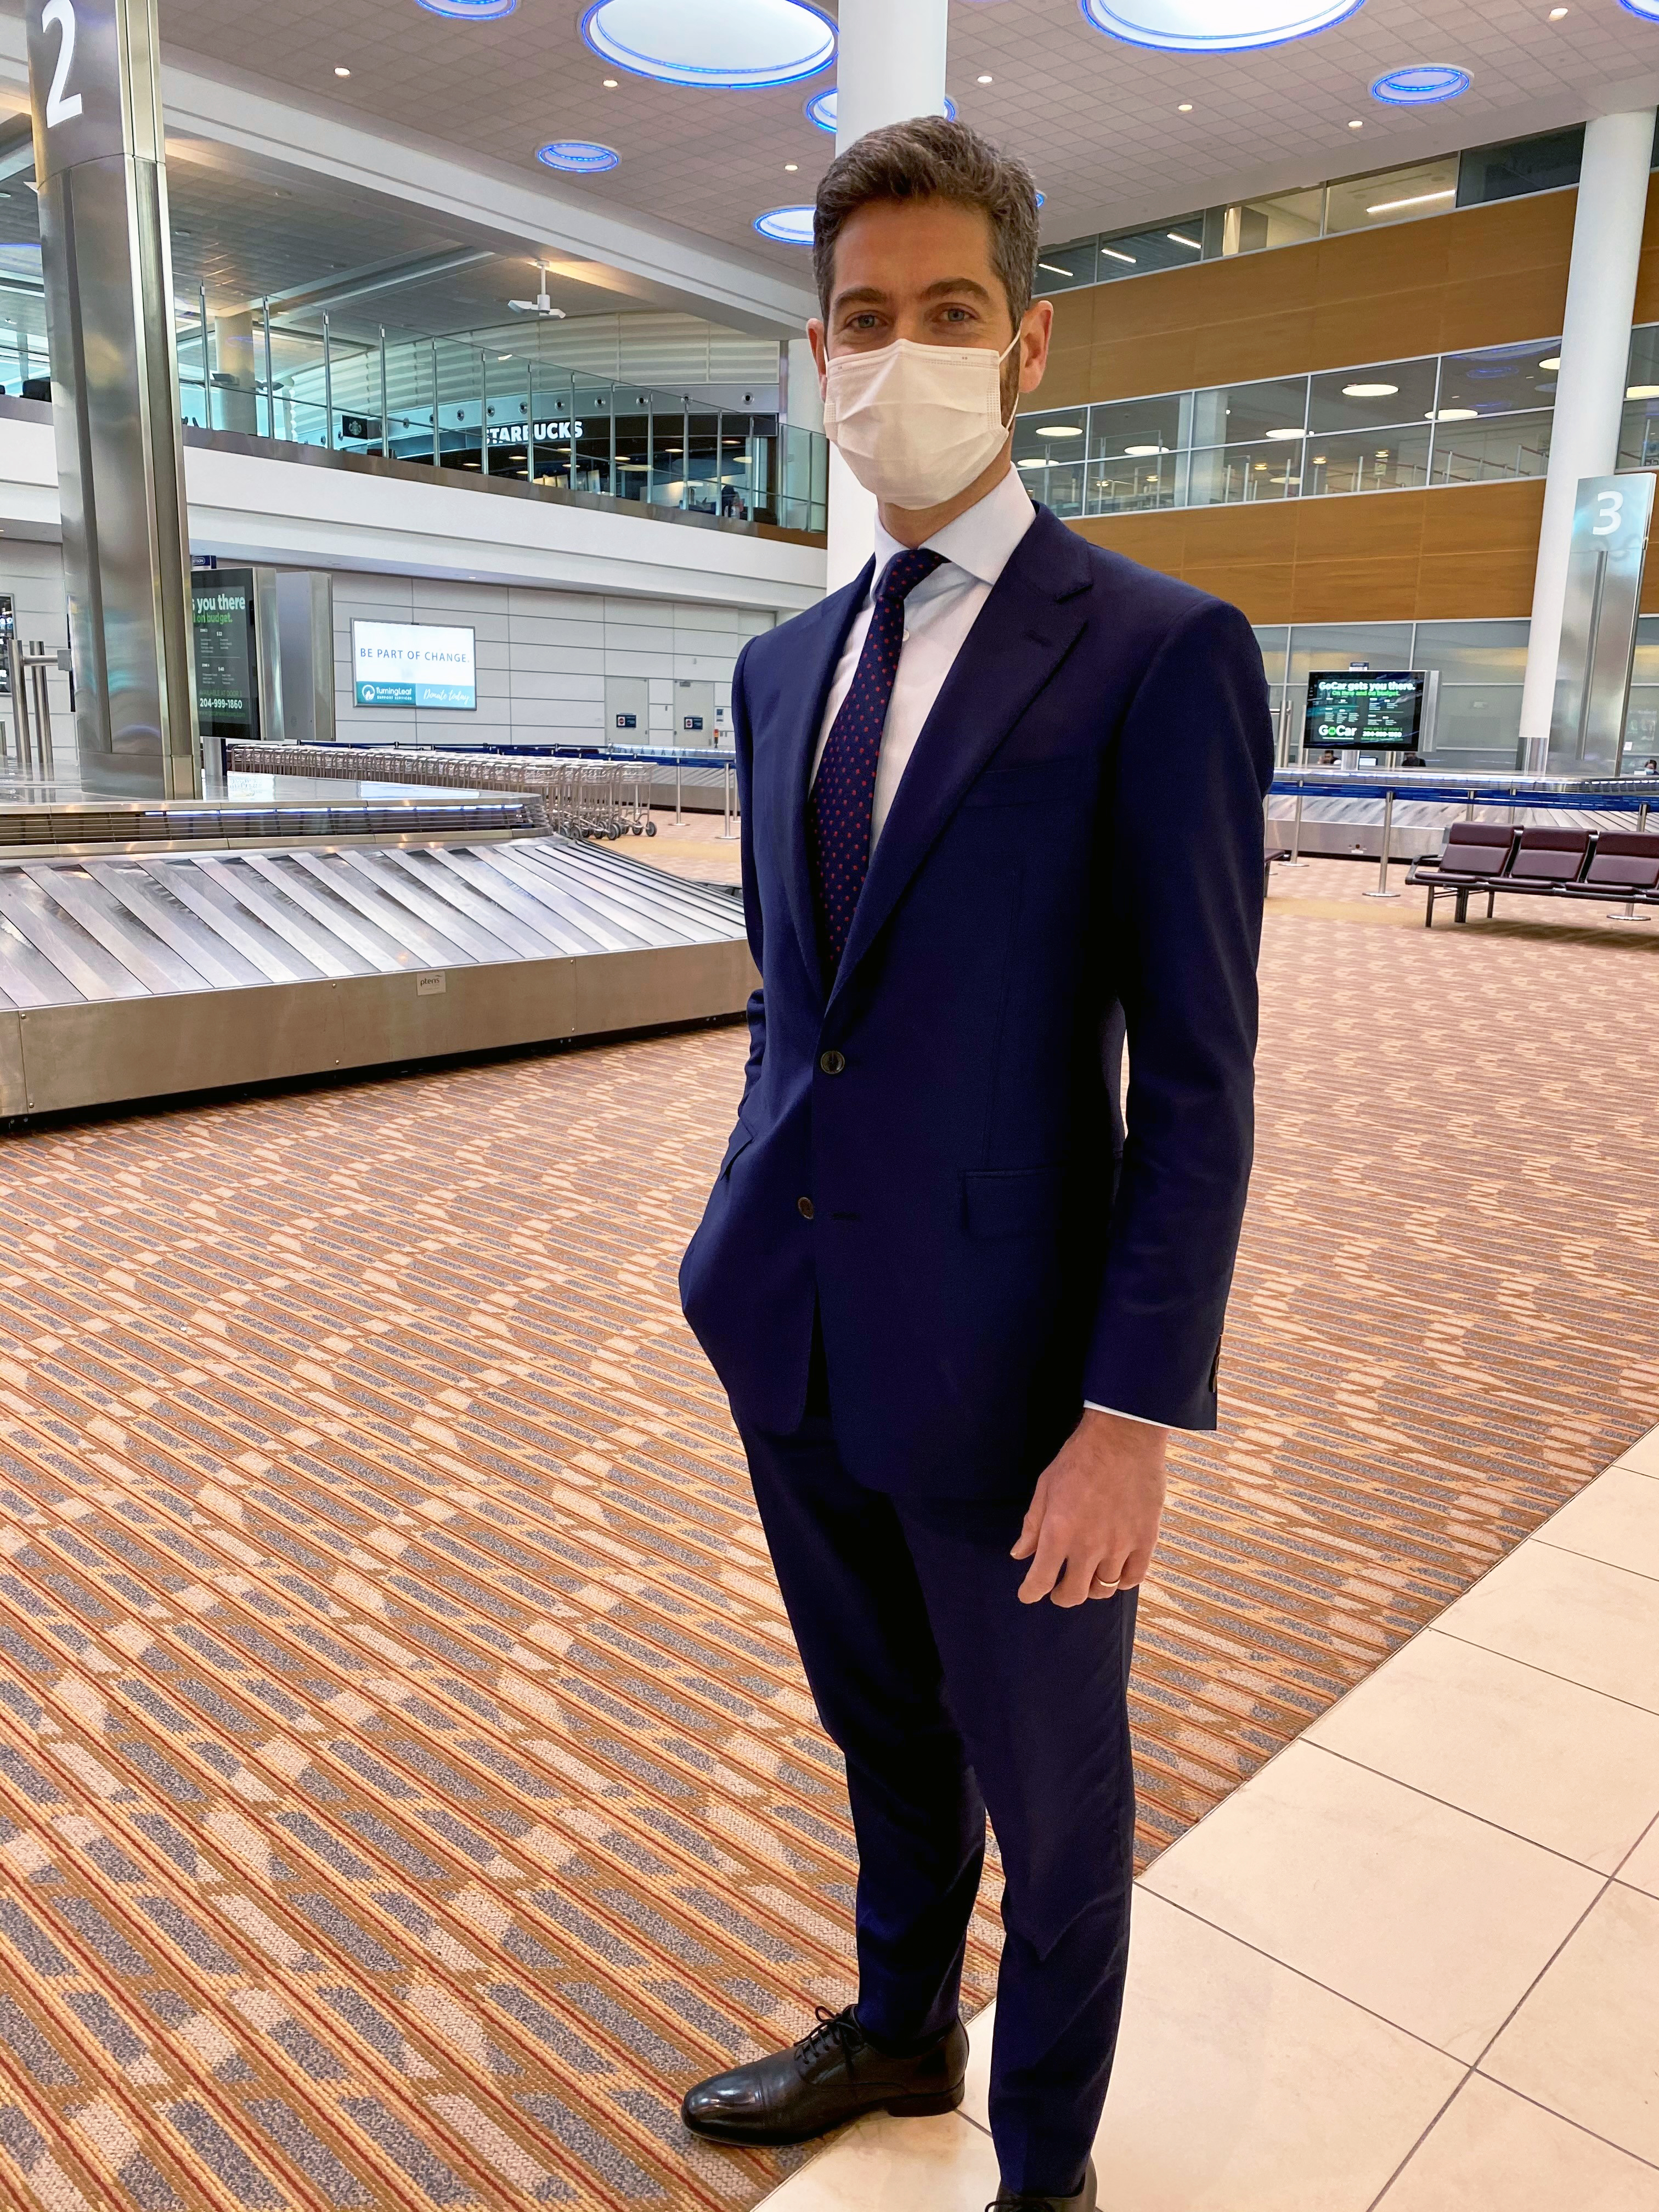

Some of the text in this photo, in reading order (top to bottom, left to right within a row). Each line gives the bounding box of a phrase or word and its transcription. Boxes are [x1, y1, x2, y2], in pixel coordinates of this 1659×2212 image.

[42, 0, 82, 128] 2
[1593, 490, 1623, 535] 3
[197, 597, 216, 614] you
[218, 594, 246, 610] there
[197, 614, 206, 623] on
[206, 613, 233, 625] budget.
[360, 648, 470, 663] BE PART OF CHANGE.
[376, 687, 412, 696] TurningLeaf
[1319, 681, 1416, 692] GoCar gets you there.
[424, 689, 448, 701] Donate
[200, 698, 242, 709] 204-999-1860
[1318, 724, 1357, 736] GoCar
